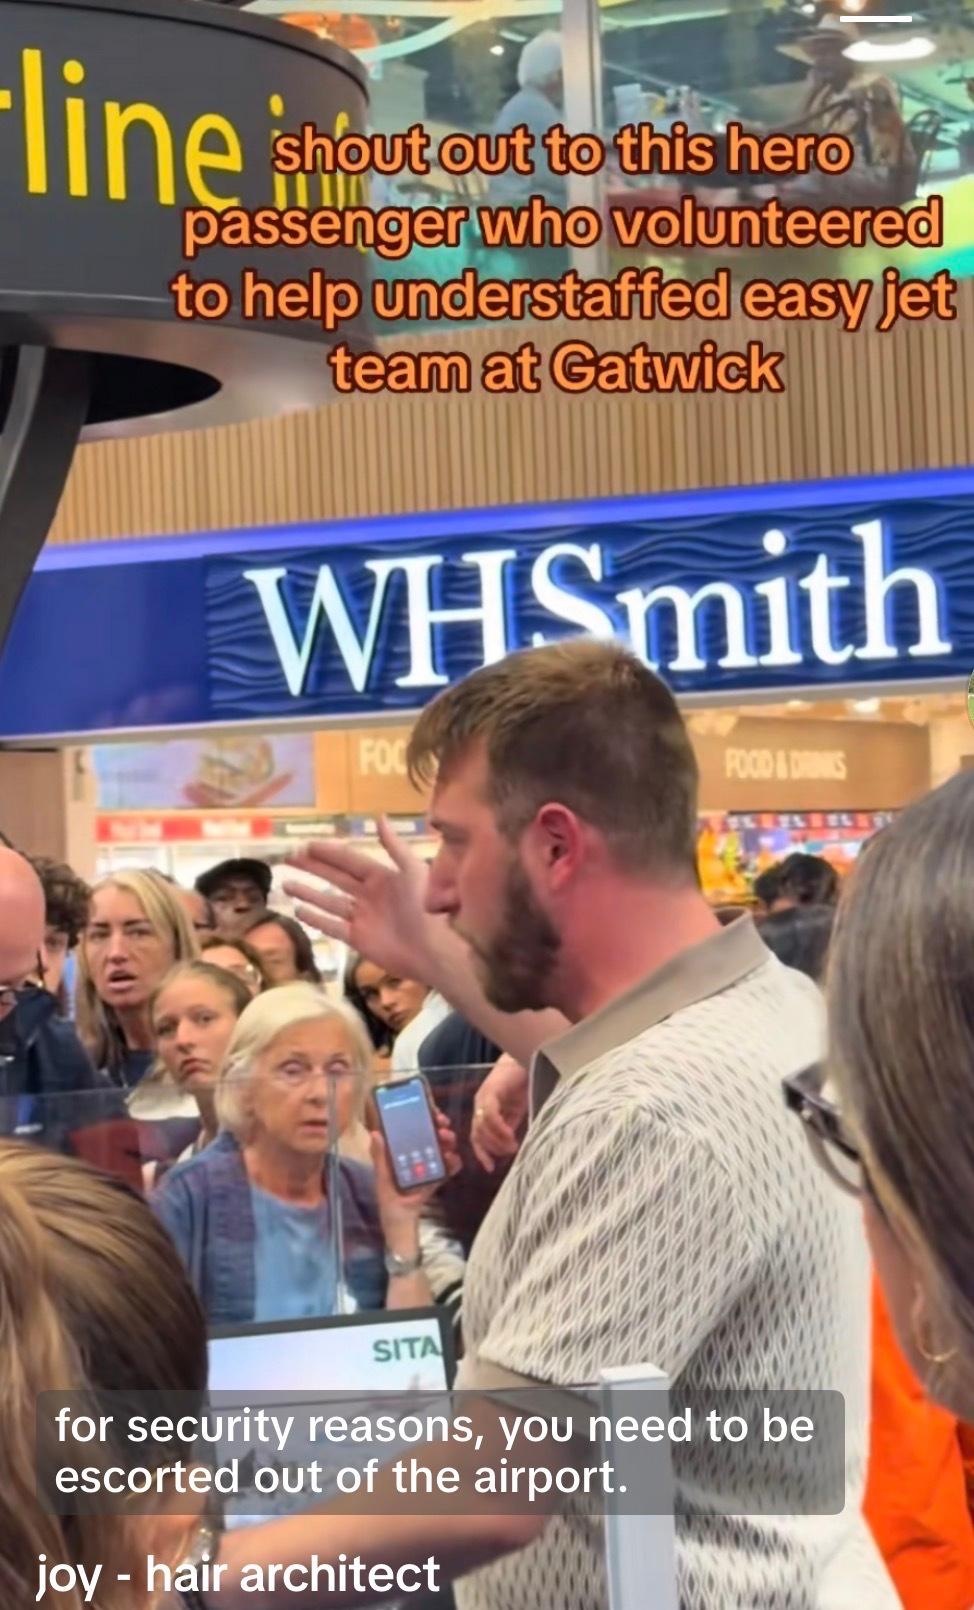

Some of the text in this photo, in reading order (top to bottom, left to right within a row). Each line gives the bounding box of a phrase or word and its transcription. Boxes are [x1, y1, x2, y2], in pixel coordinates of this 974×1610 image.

[0, 48, 243, 213] line
[243, 520, 953, 697] WHSmith
[725, 748, 773, 779] FOOD
